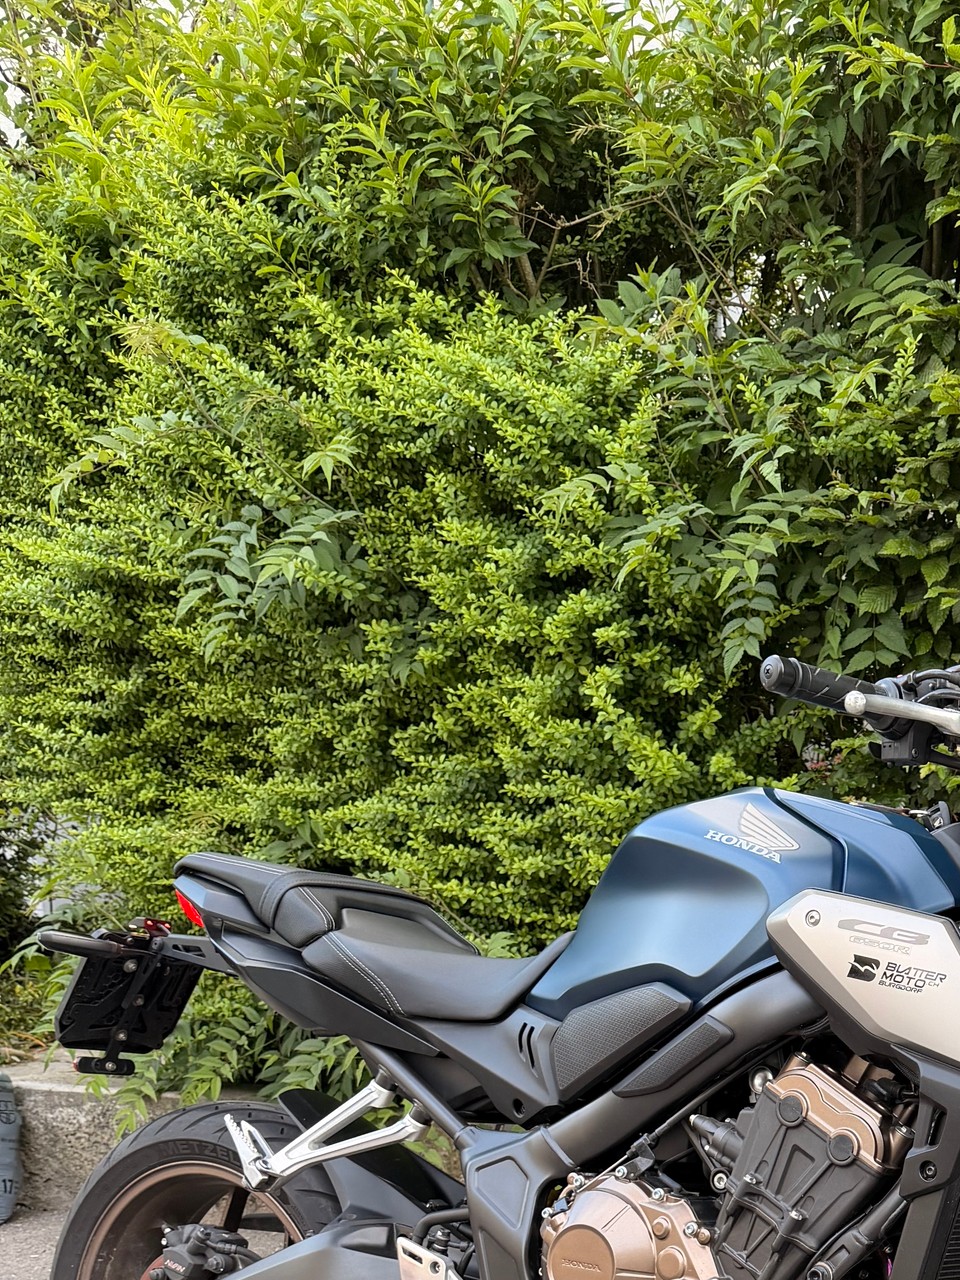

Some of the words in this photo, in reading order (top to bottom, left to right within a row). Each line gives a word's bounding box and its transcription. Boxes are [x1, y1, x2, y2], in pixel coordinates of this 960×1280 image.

[703, 829, 782, 864] HONDA
[838, 919, 930, 945] CB
[849, 935, 911, 955] 650R
[885, 961, 947, 983] BLATTER
[878, 980, 923, 993] BURGDORF
[158, 1140, 242, 1167] METZEL
[561, 1258, 601, 1272] HONDA
